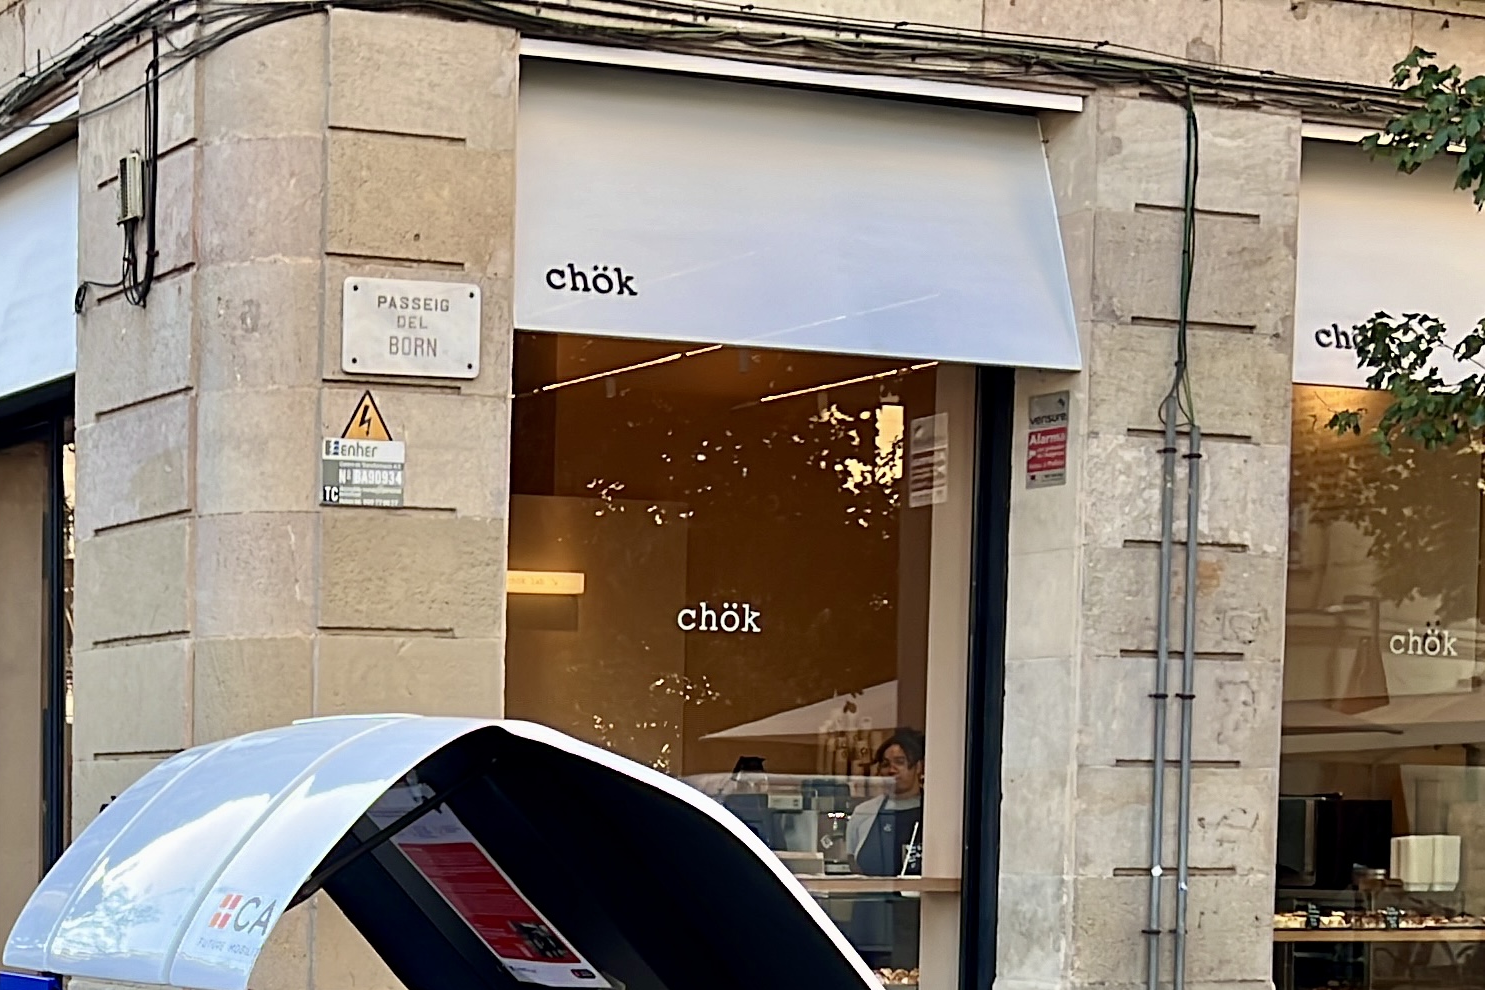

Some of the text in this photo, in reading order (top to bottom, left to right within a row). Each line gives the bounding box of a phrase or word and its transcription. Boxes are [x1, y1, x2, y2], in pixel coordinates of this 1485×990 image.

[544, 263, 638, 296] chök
[377, 295, 450, 312] PASSEIG
[396, 315, 429, 329] DEL
[389, 336, 438, 358] BORN
[340, 441, 378, 458] enher
[324, 486, 339, 502] TC
[677, 601, 761, 633] chök
[1389, 627, 1458, 656] chök
[233, 896, 278, 936] CA
